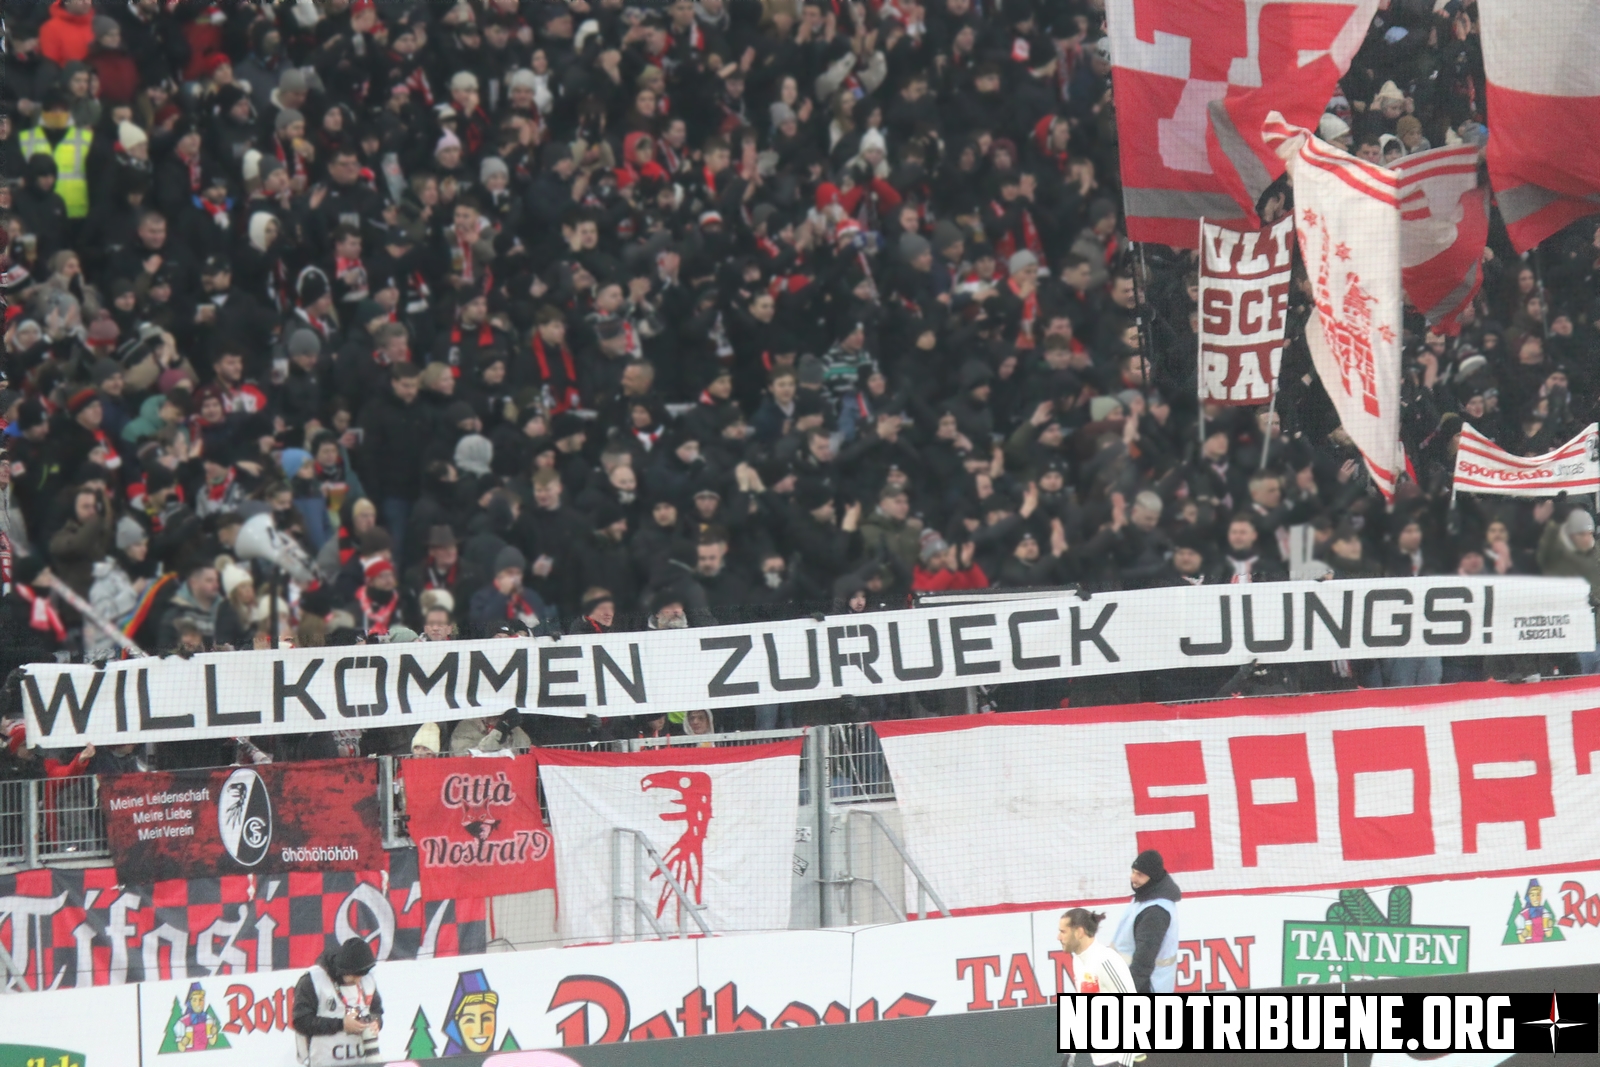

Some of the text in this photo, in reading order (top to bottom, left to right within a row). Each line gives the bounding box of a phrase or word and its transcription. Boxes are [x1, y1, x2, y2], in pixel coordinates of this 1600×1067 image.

[1513, 614, 1570, 628] FREIBURG
[1519, 628, 1566, 640] ASOZIAL
[23, 585, 1494, 737] WILLKOMMEN ZURUECK JUNGS!
[442, 772, 515, 808] Città
[110, 787, 210, 811] Meine Leidenschaft
[165, 807, 192, 820] Liebe
[163, 824, 194, 838] Verein
[282, 846, 358, 862] öhöhöhöhöh
[1291, 930, 1462, 965] TANNEN
